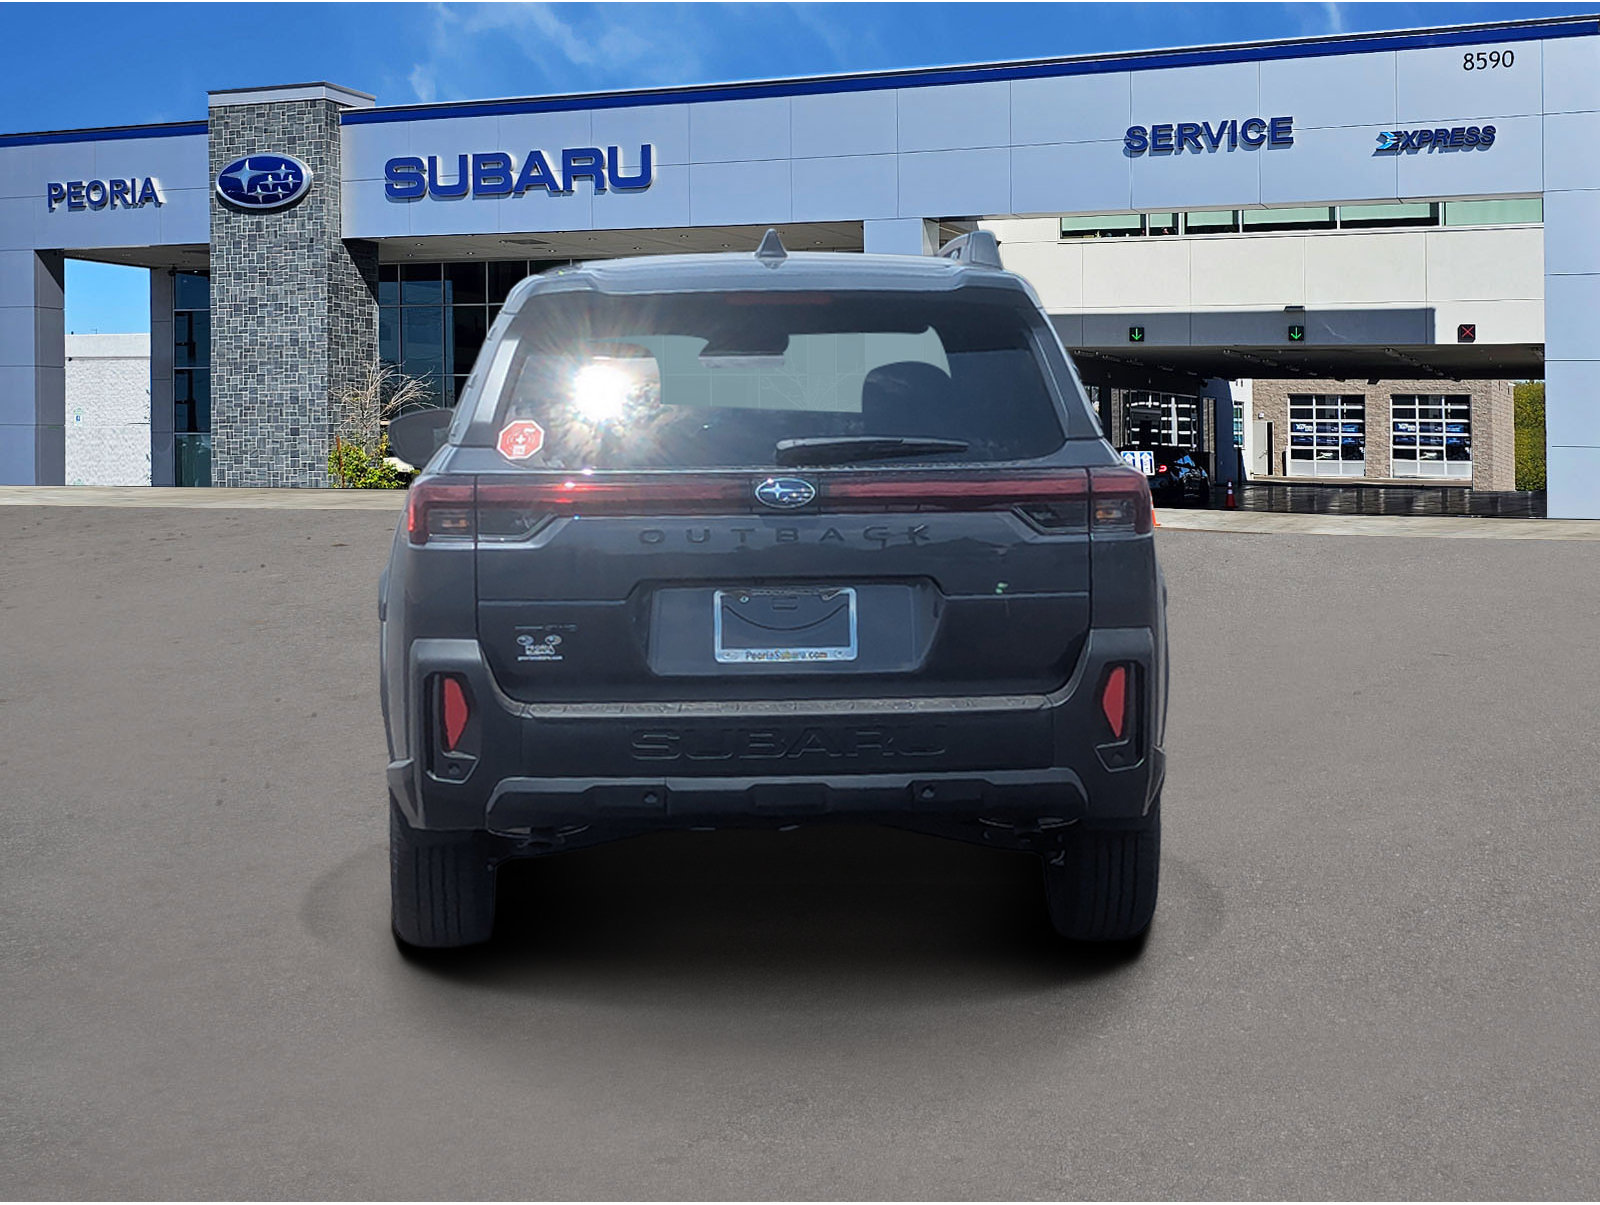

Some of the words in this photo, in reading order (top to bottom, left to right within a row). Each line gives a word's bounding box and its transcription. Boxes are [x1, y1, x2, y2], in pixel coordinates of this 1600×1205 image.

[1463, 50, 1515, 71] 8590
[1125, 116, 1294, 153] SERVICE
[1375, 125, 1496, 152] EXPRESS
[385, 143, 652, 200] SUBARU
[48, 177, 162, 211] PEORIA
[639, 525, 932, 547] OUTBACK
[631, 725, 947, 760] SUBARU
